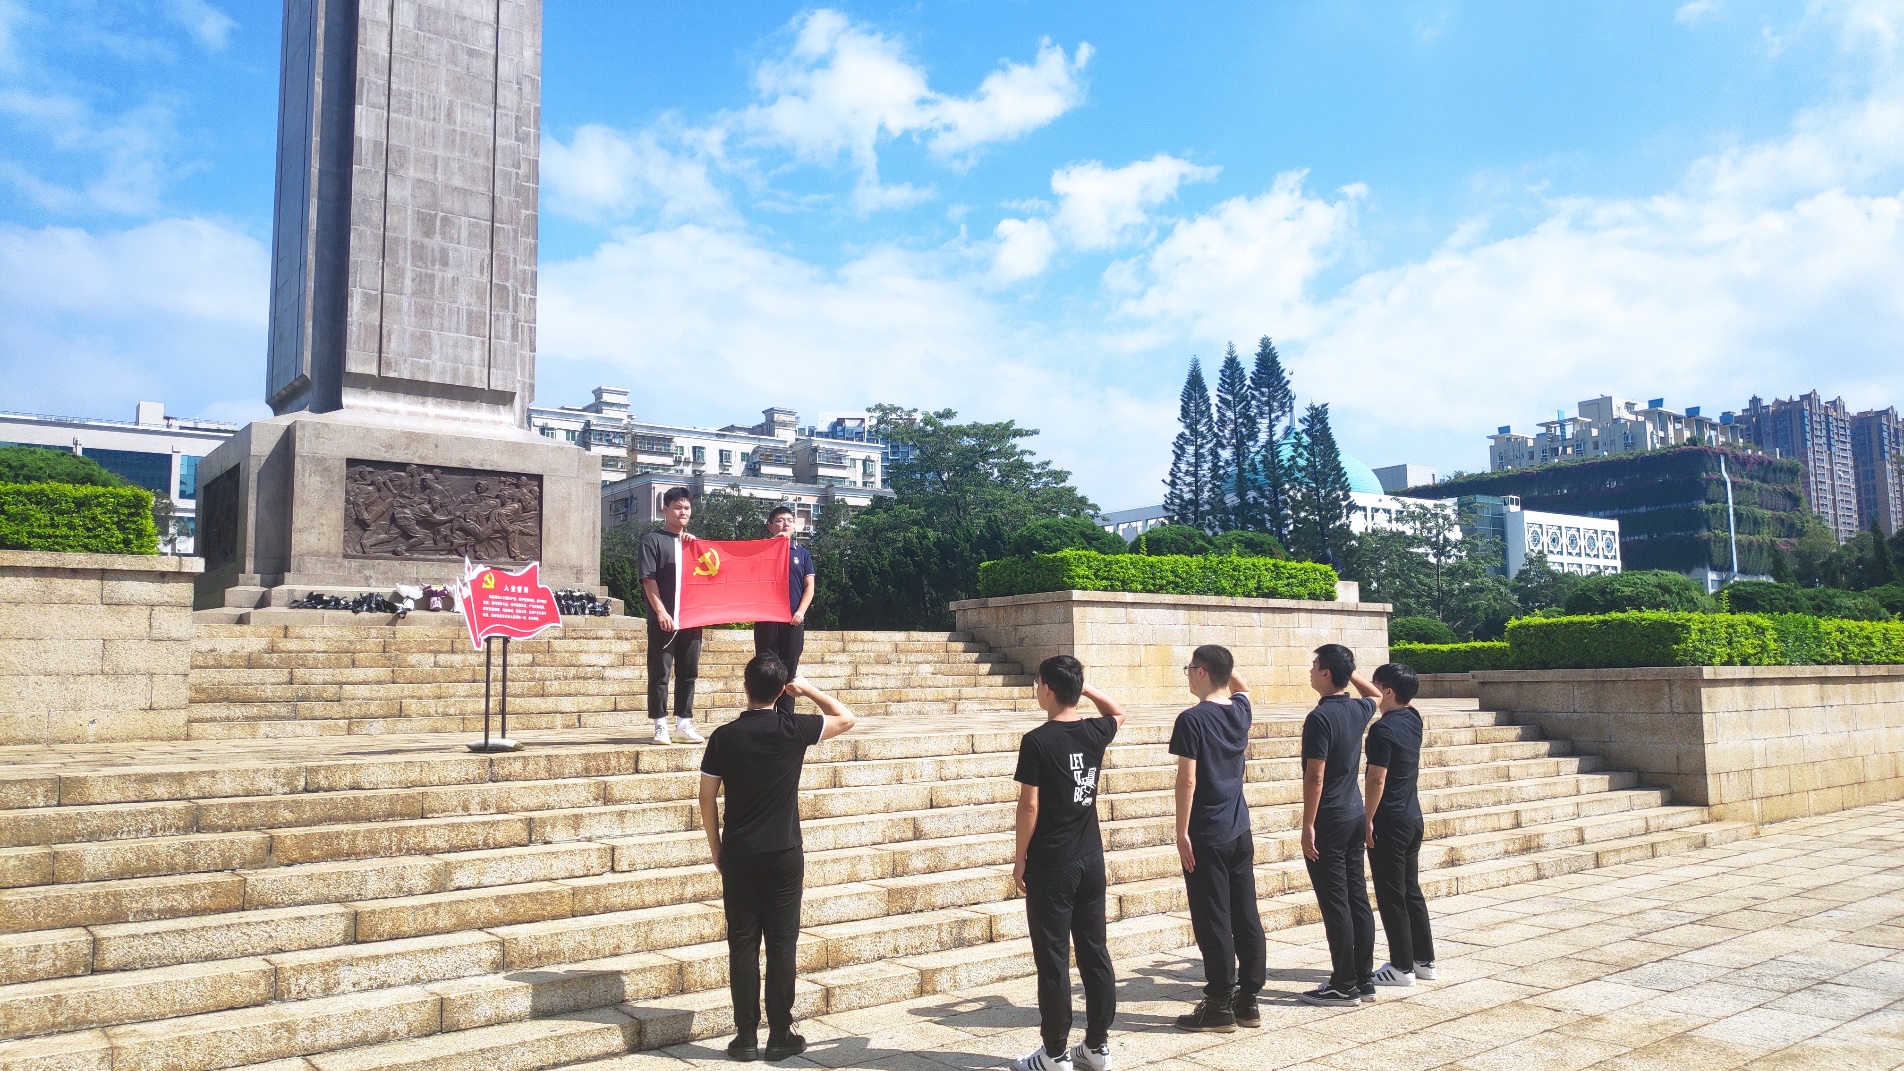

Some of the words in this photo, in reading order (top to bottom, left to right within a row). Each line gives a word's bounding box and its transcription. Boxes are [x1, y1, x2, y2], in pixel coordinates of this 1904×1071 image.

[1069, 753, 1084, 770] LET
[1073, 770, 1083, 785] IT
[1074, 786, 1085, 803] BE
